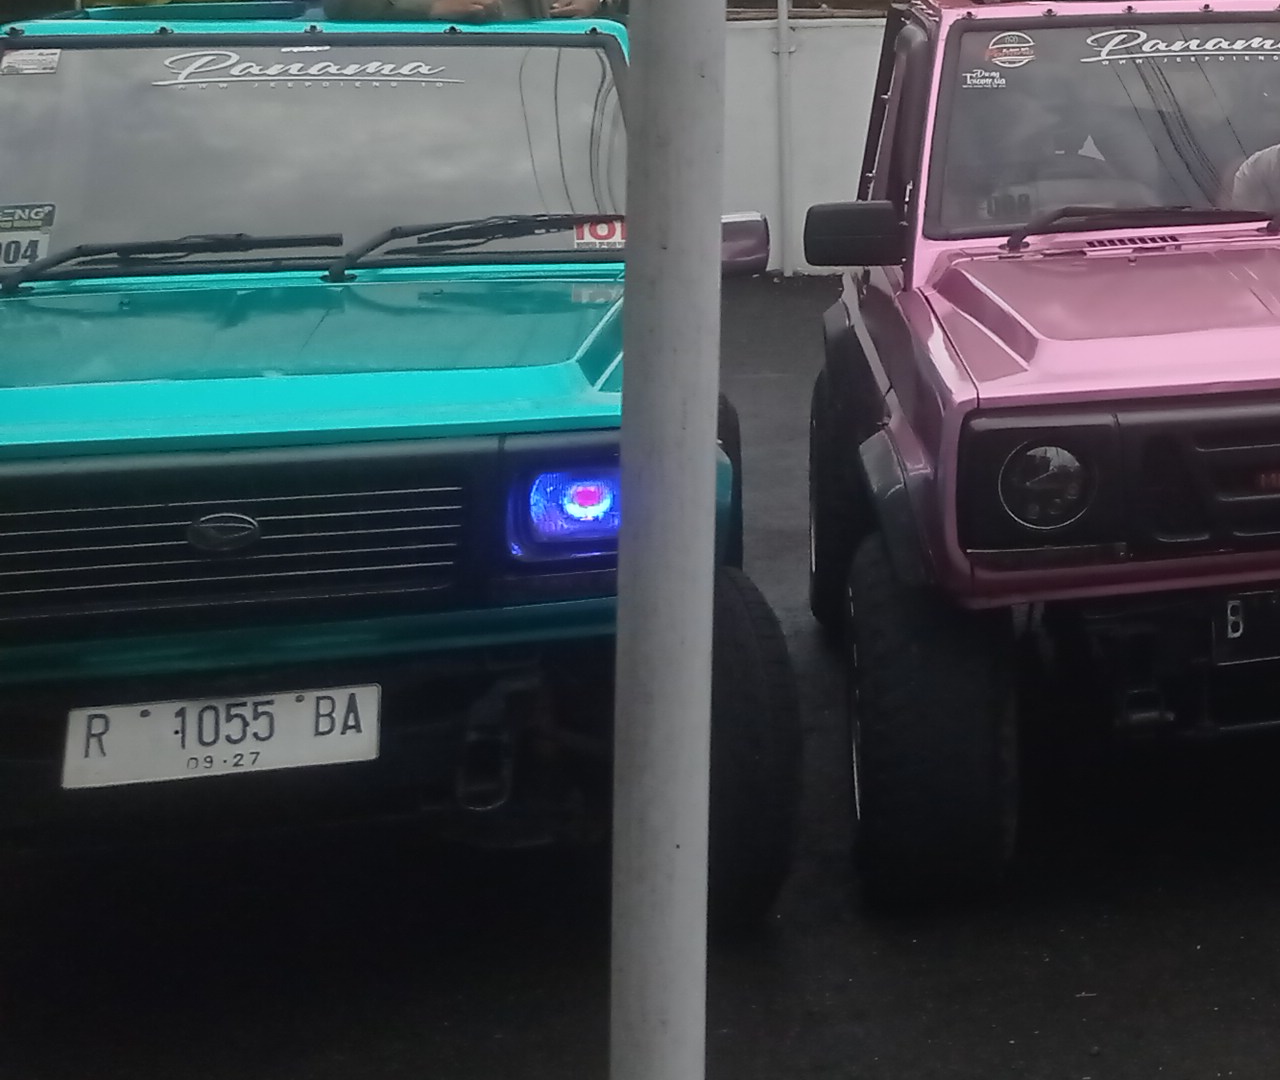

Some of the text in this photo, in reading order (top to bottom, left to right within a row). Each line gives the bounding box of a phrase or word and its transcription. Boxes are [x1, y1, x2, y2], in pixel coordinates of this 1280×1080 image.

[164, 50, 446, 81] Panama
[0, 239, 40, 265] 04
[1227, 600, 1244, 638] B
[83, 692, 363, 759] R 1055 BA
